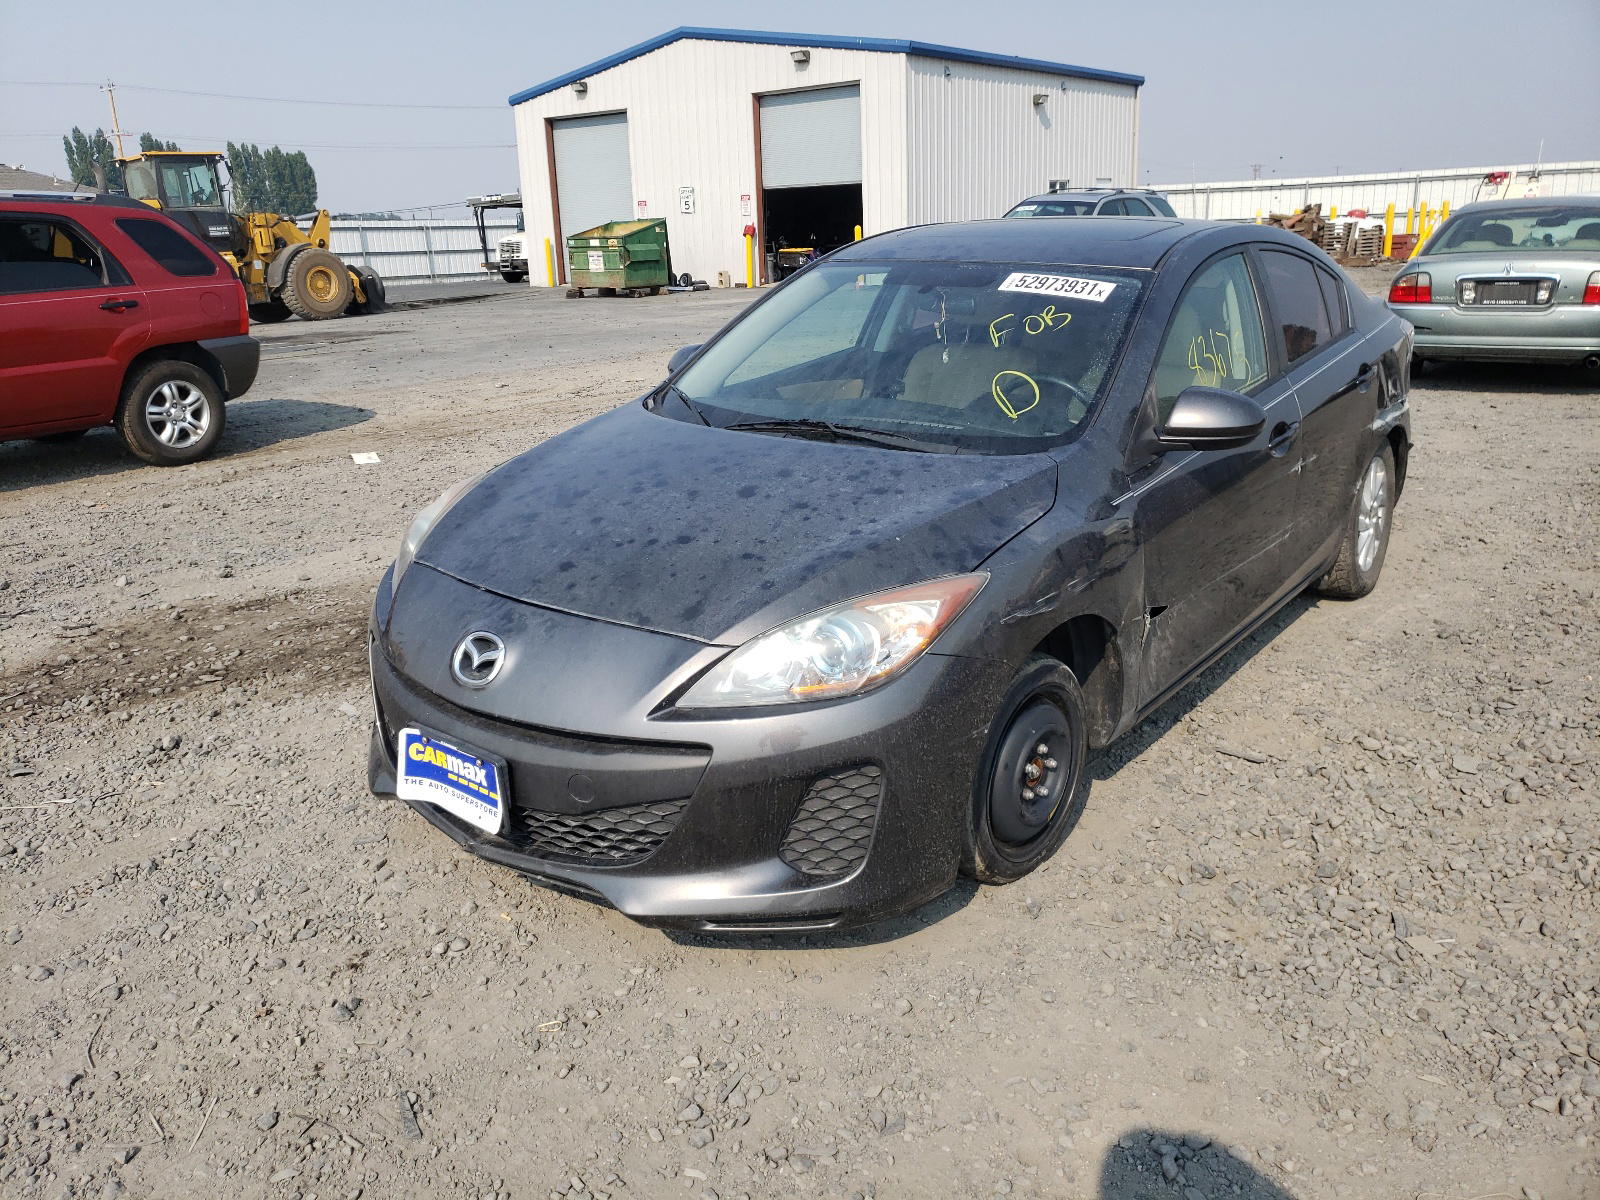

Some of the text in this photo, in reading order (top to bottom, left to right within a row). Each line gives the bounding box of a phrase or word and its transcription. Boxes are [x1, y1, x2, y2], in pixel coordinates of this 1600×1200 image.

[684, 200, 691, 211] 5
[1015, 275, 1099, 296] 52973931
[404, 778, 499, 818] THE AUTO SUPERSTORE
